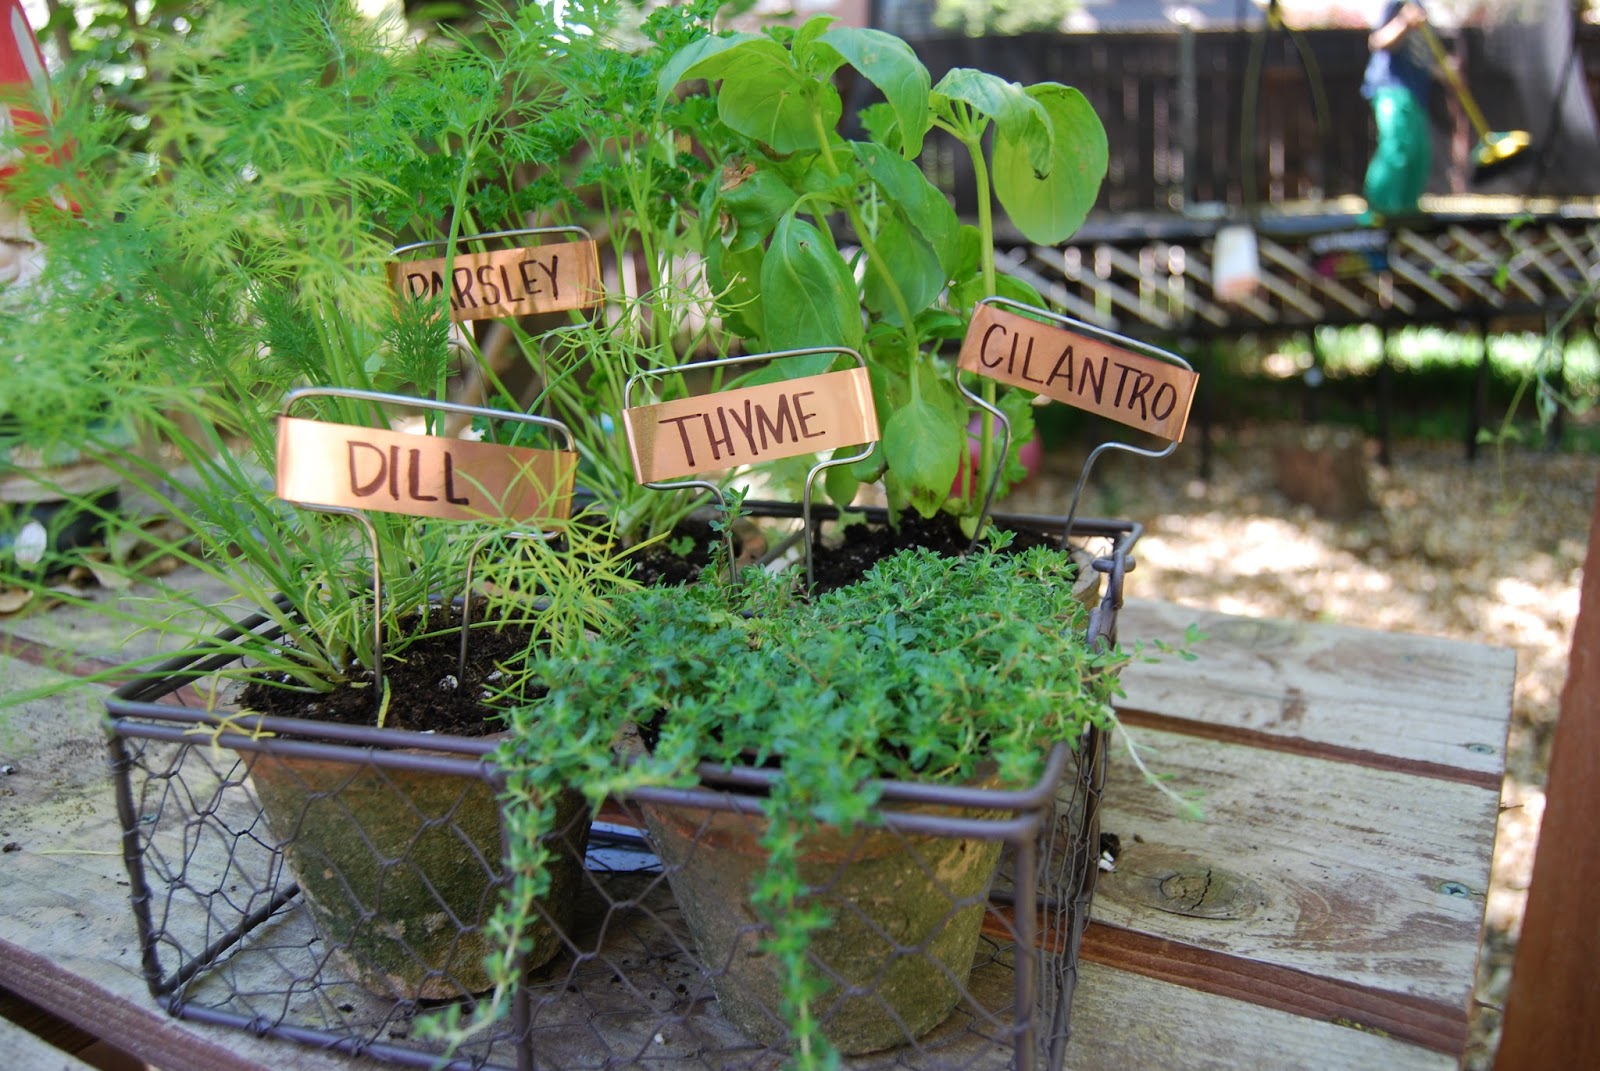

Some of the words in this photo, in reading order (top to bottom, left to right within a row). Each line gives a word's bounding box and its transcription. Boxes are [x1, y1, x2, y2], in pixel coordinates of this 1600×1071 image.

[980, 323, 1177, 421] CILANTRO
[658, 391, 826, 467] THYME
[347, 440, 470, 505] DILL
